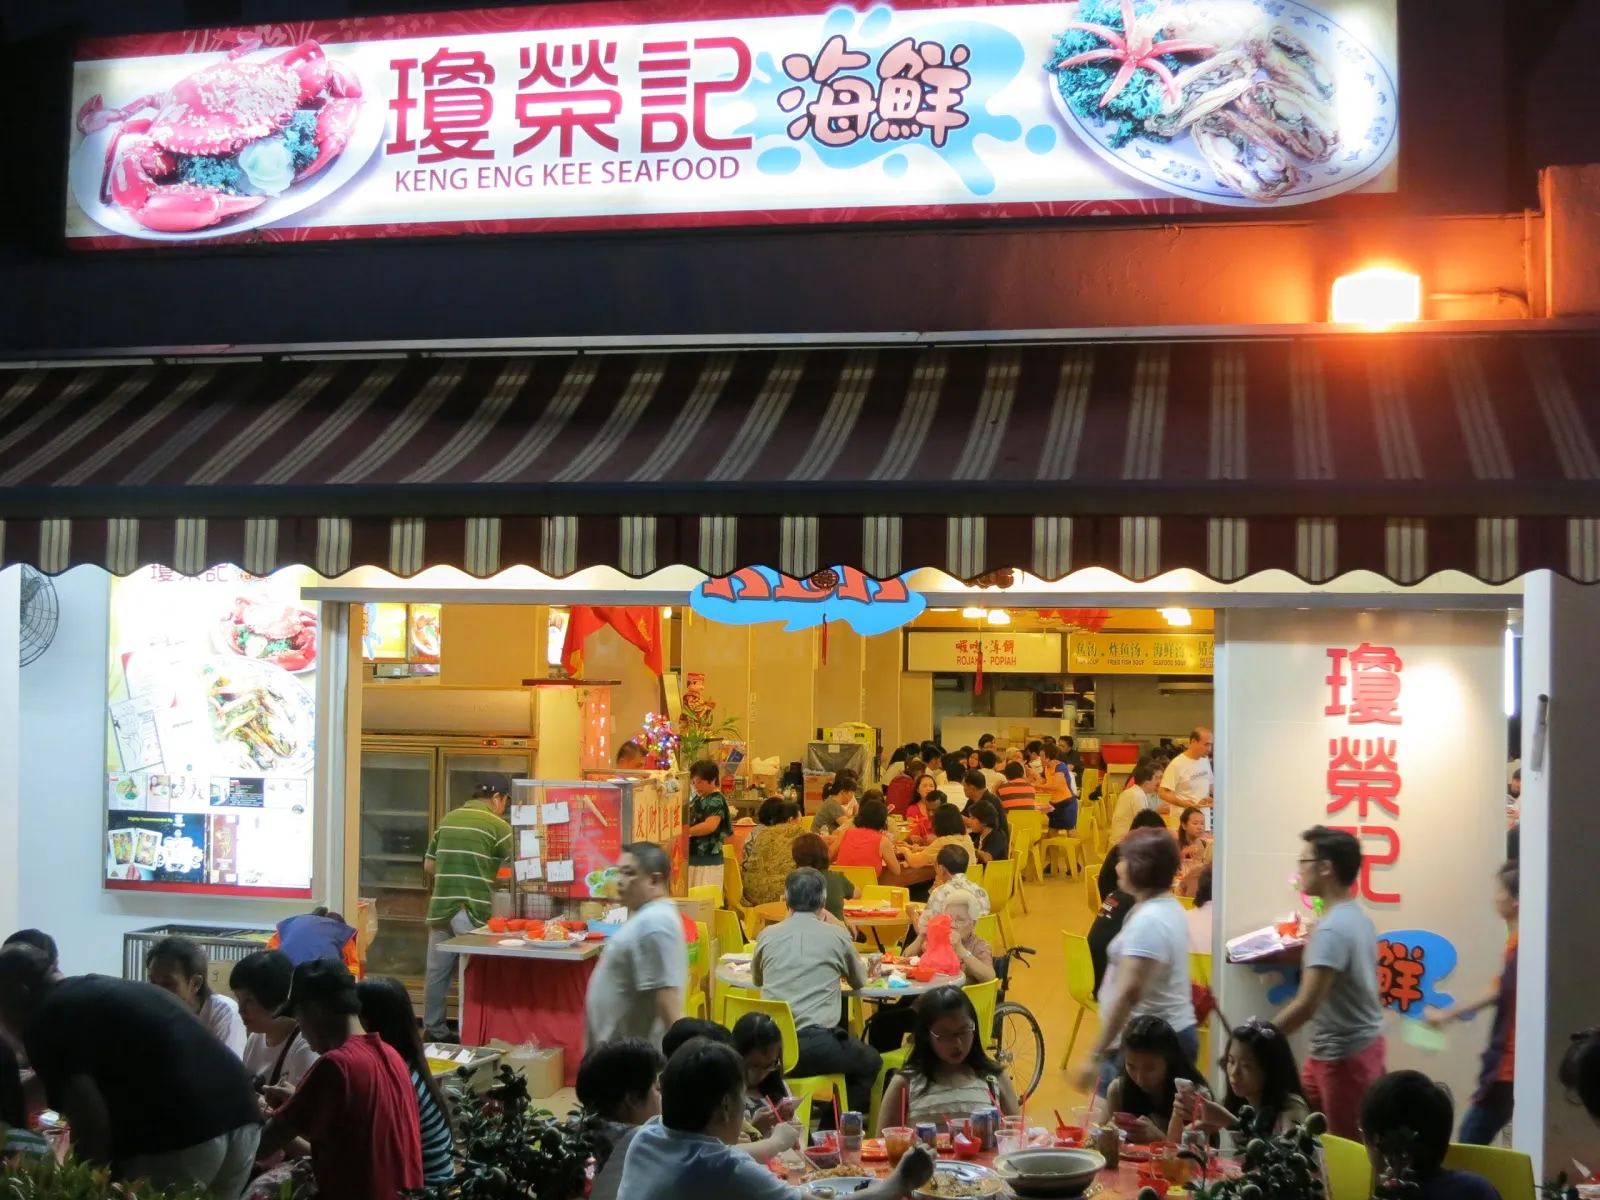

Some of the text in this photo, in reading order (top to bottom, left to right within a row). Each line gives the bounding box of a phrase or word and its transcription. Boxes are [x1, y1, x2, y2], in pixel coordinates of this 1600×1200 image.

[386, 34, 971, 163] 瓊榮記 海鮮
[395, 154, 740, 193] KENG ENG KEE SEAFOOD
[990, 656, 1017, 666] POPIAH
